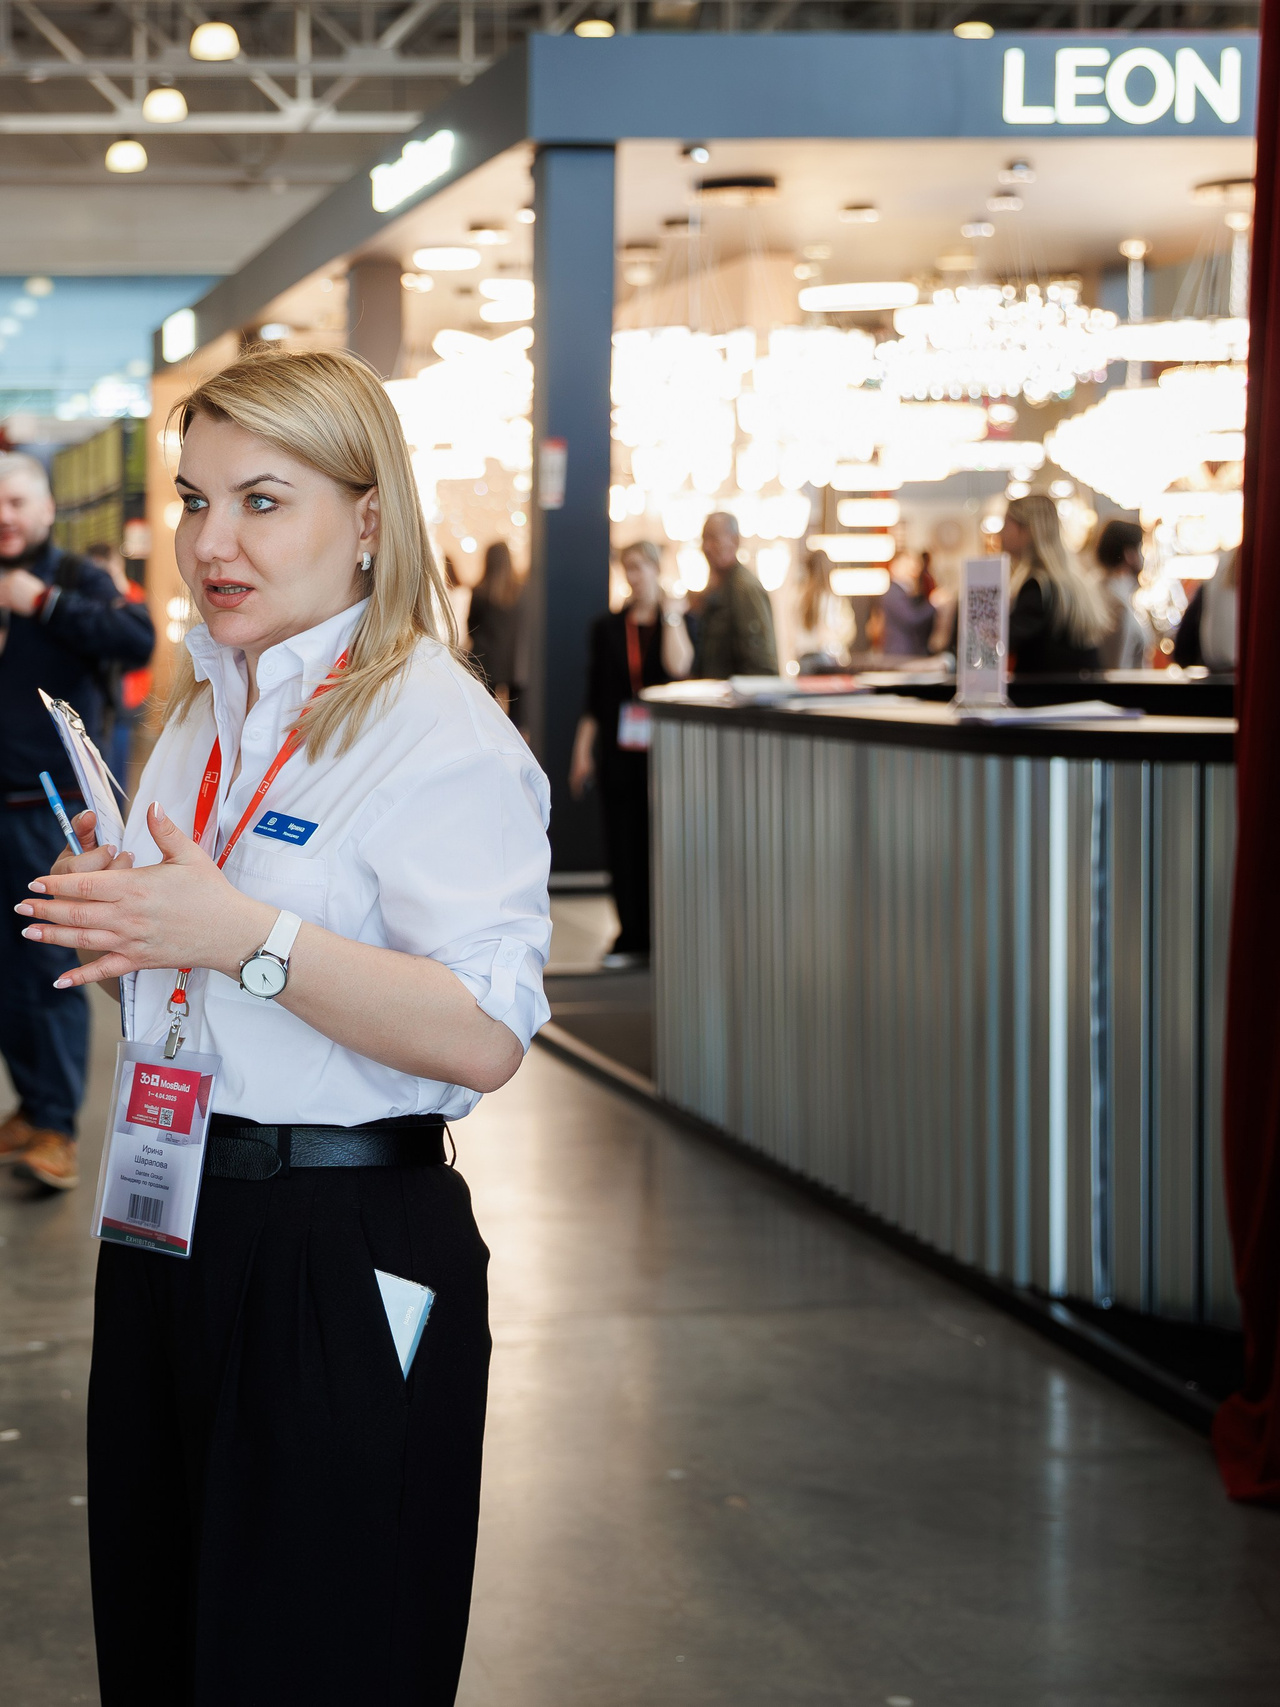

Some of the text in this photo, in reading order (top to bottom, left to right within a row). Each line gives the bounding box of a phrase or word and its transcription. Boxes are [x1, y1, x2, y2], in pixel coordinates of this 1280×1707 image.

[1003, 47, 1242, 125] LEON
[160, 1079, 191, 1093] MosBuild
[142, 1144, 163, 1156] Ирина
[134, 1154, 168, 1170] Шарапова
[150, 1172, 163, 1181] Group
[403, 1305, 415, 1326] Redmi
